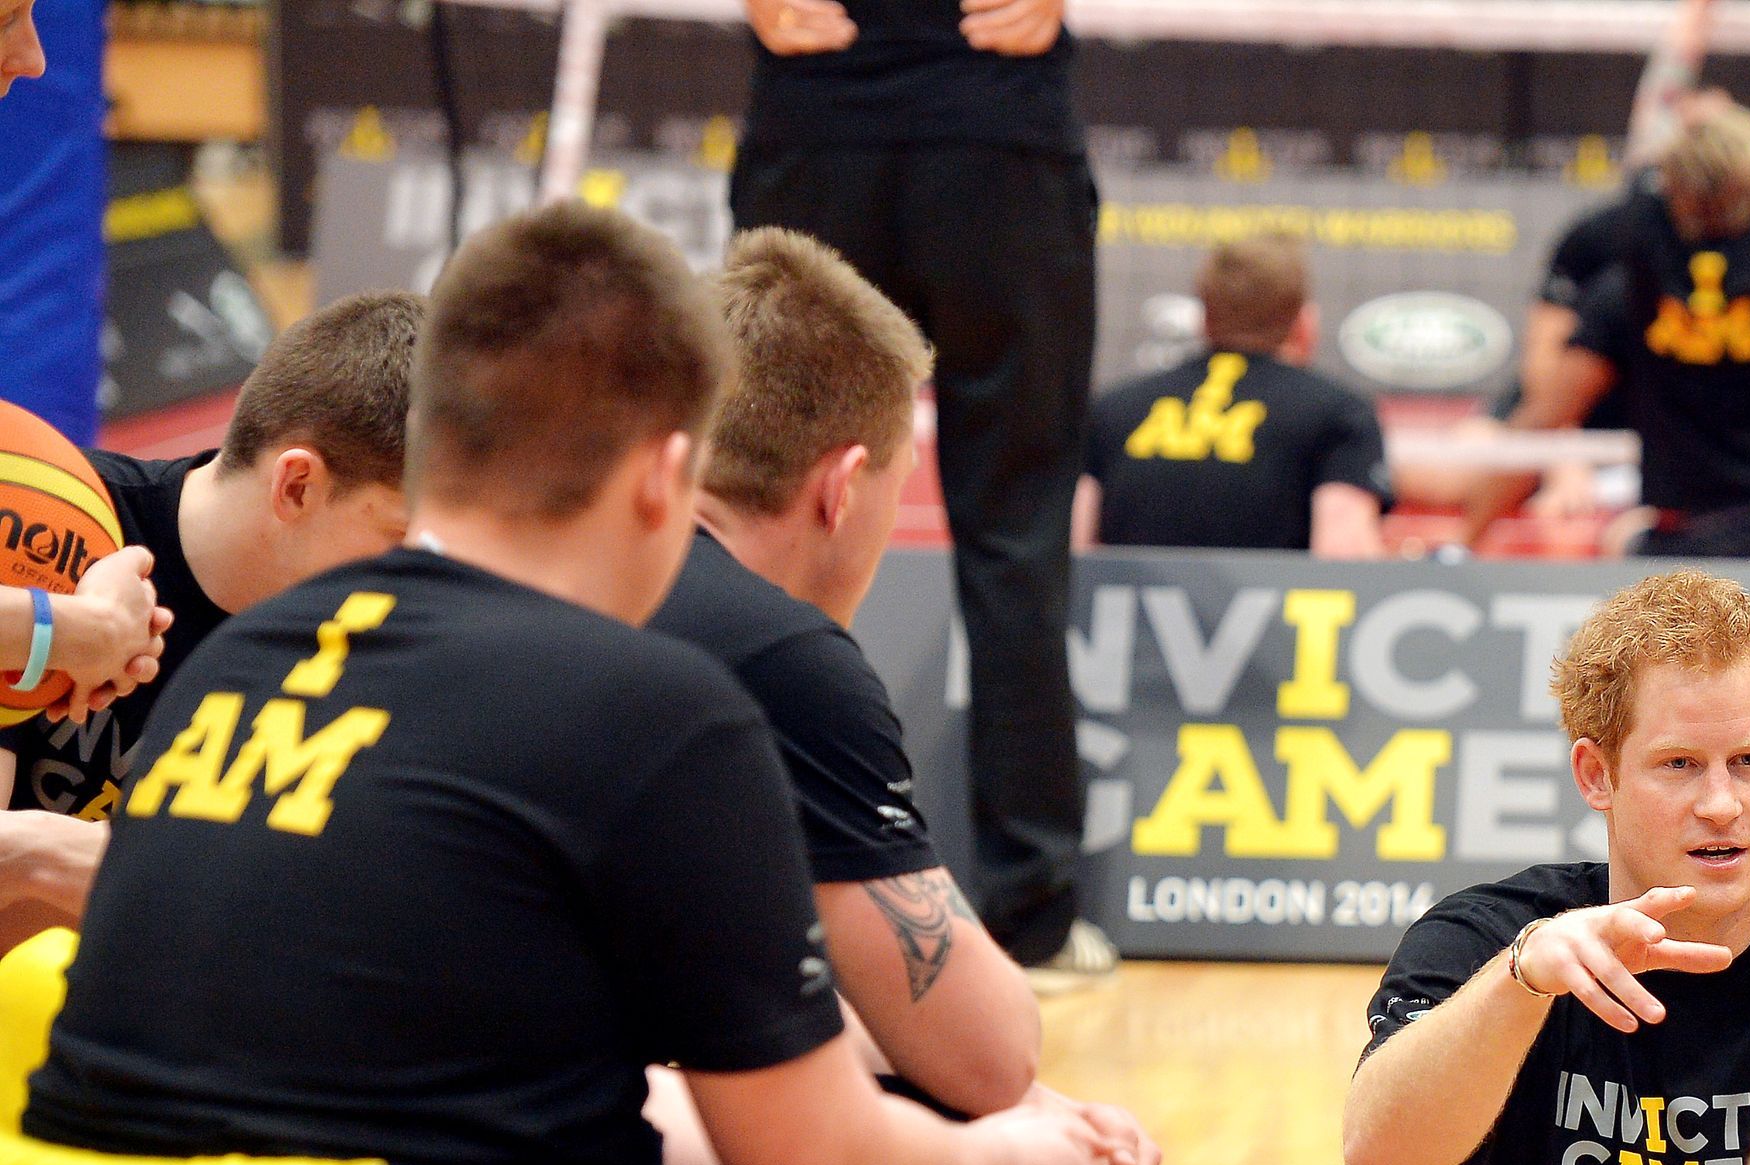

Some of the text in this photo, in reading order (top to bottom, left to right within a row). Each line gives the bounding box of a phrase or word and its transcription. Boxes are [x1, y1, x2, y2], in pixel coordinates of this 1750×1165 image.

[281, 590, 397, 698] I
[126, 691, 392, 837] AM
[1127, 874, 1328, 926] LONDON
